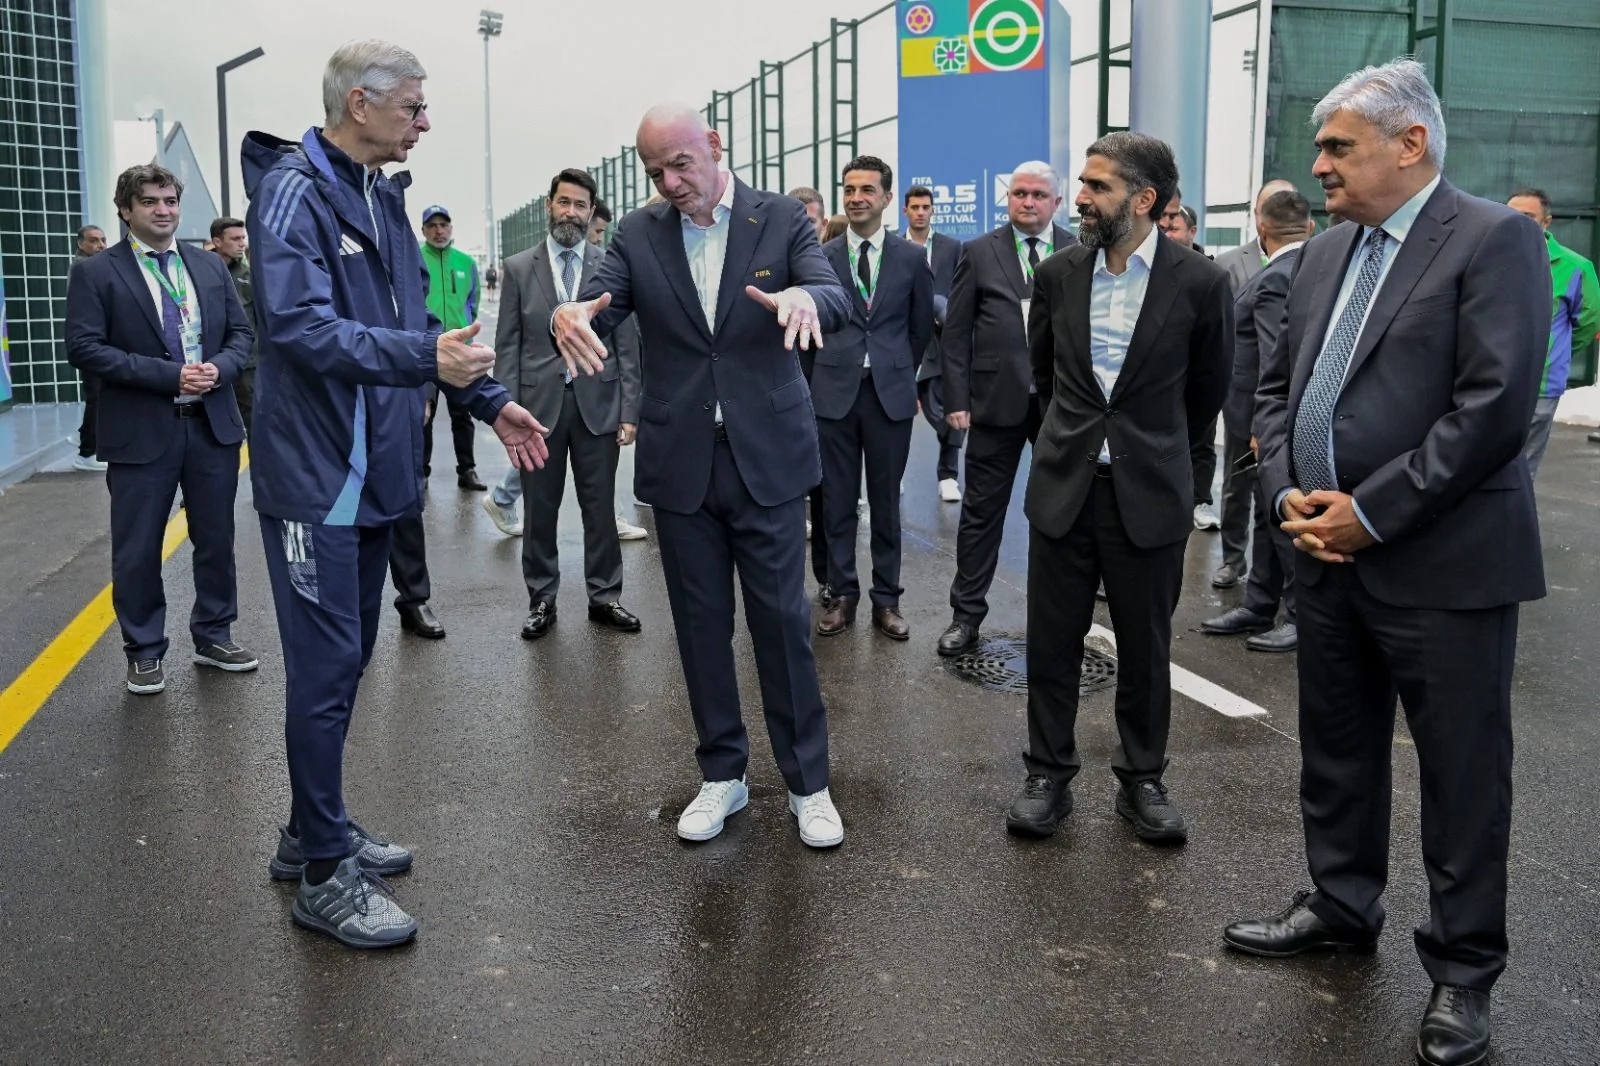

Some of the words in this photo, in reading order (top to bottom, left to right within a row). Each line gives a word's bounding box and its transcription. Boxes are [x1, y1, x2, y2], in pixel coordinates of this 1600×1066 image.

[912, 176, 933, 185] FIFA
[926, 185, 977, 203] 15
[955, 203, 977, 214] CUP
[930, 214, 977, 224] ESTIVAL
[755, 269, 771, 278] FIFA
